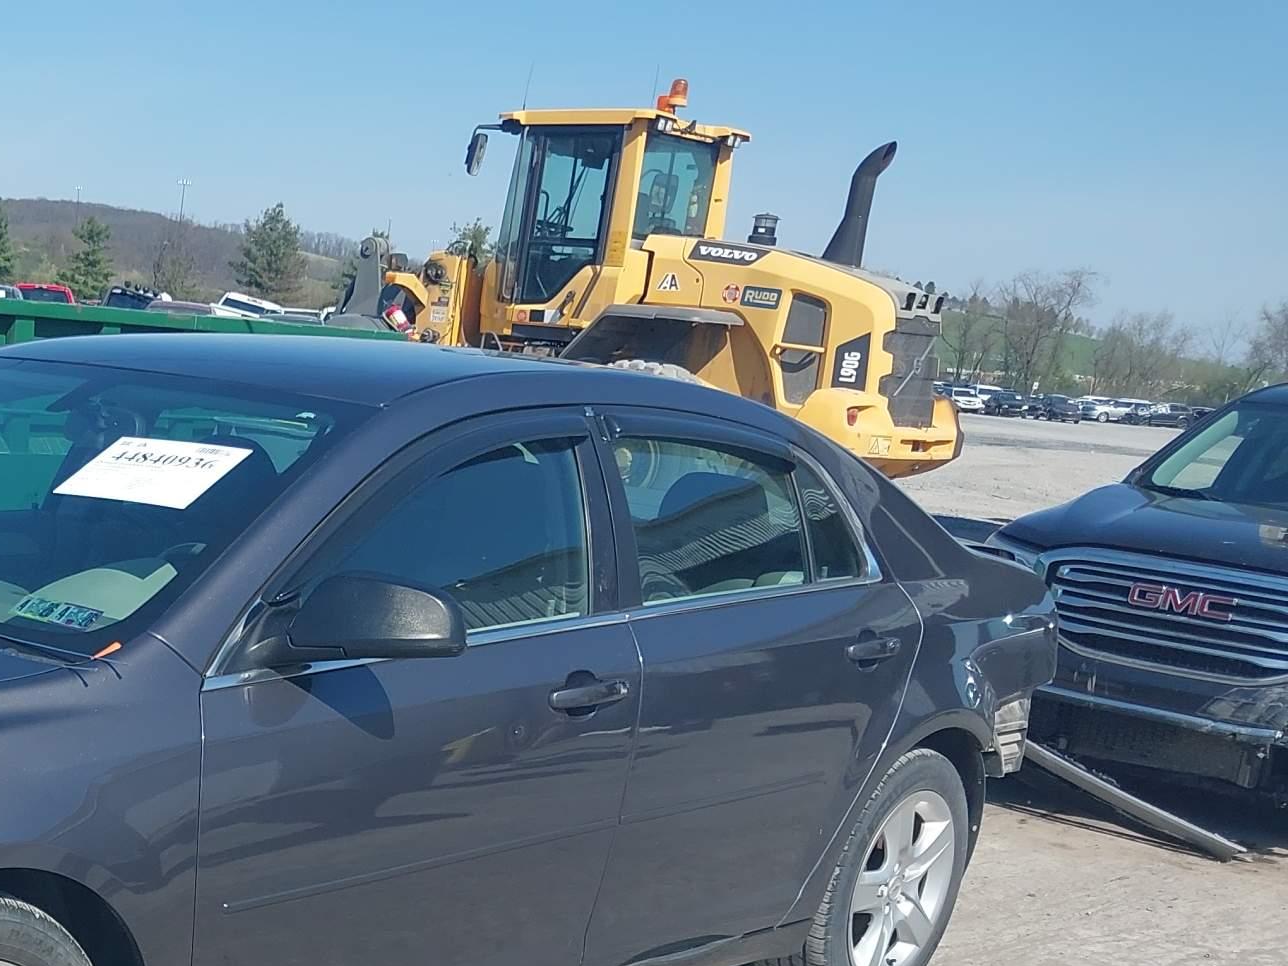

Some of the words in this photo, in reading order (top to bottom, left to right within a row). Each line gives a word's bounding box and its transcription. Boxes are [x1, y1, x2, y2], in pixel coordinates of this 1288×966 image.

[698, 245, 758, 261] VOLVO
[838, 351, 861, 383] L90G
[112, 450, 218, 469] 44840936
[1128, 582, 1239, 621] GMC
